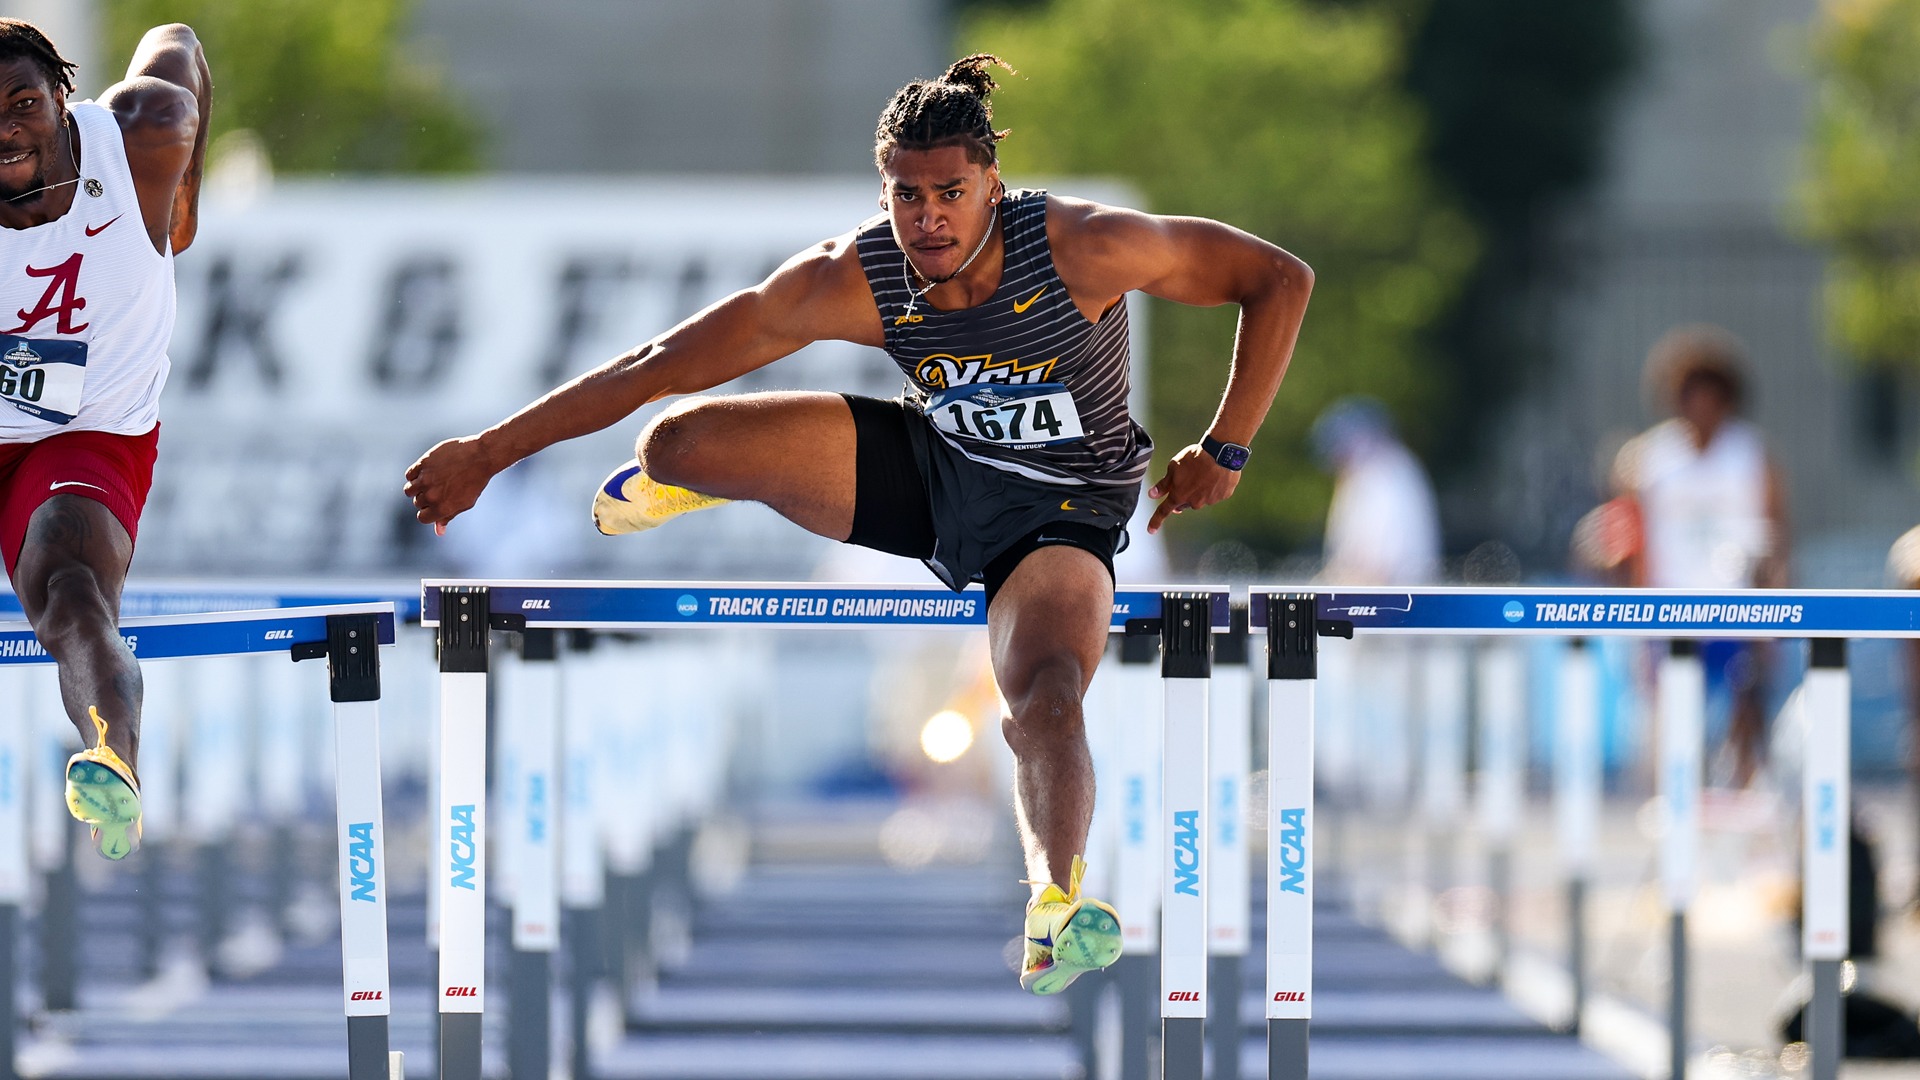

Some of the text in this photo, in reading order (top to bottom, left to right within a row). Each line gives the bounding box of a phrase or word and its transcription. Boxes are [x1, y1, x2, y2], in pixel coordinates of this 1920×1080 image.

[0, 252, 90, 335] A
[948, 399, 1062, 440] 1674
[1013, 443, 1047, 451] KENTUCKY
[522, 599, 552, 610] GILL
[709, 597, 976, 618] TRACK & FIELD CHAMPIONSHIPS
[1111, 604, 1131, 614] ILL
[1348, 606, 1377, 616] GILL
[1535, 603, 1804, 623] TRACK & FIELD CHAMPIONSHIPS
[264, 629, 294, 641] GILL
[451, 804, 476, 891] NCAA
[1174, 810, 1199, 897] NCAA
[1280, 807, 1306, 895] NCAA
[349, 822, 376, 903] NCAA
[350, 990, 383, 1001] GILL
[445, 986, 478, 997] GILL
[1168, 991, 1201, 1002] GILL
[1273, 991, 1306, 1002] GILL
